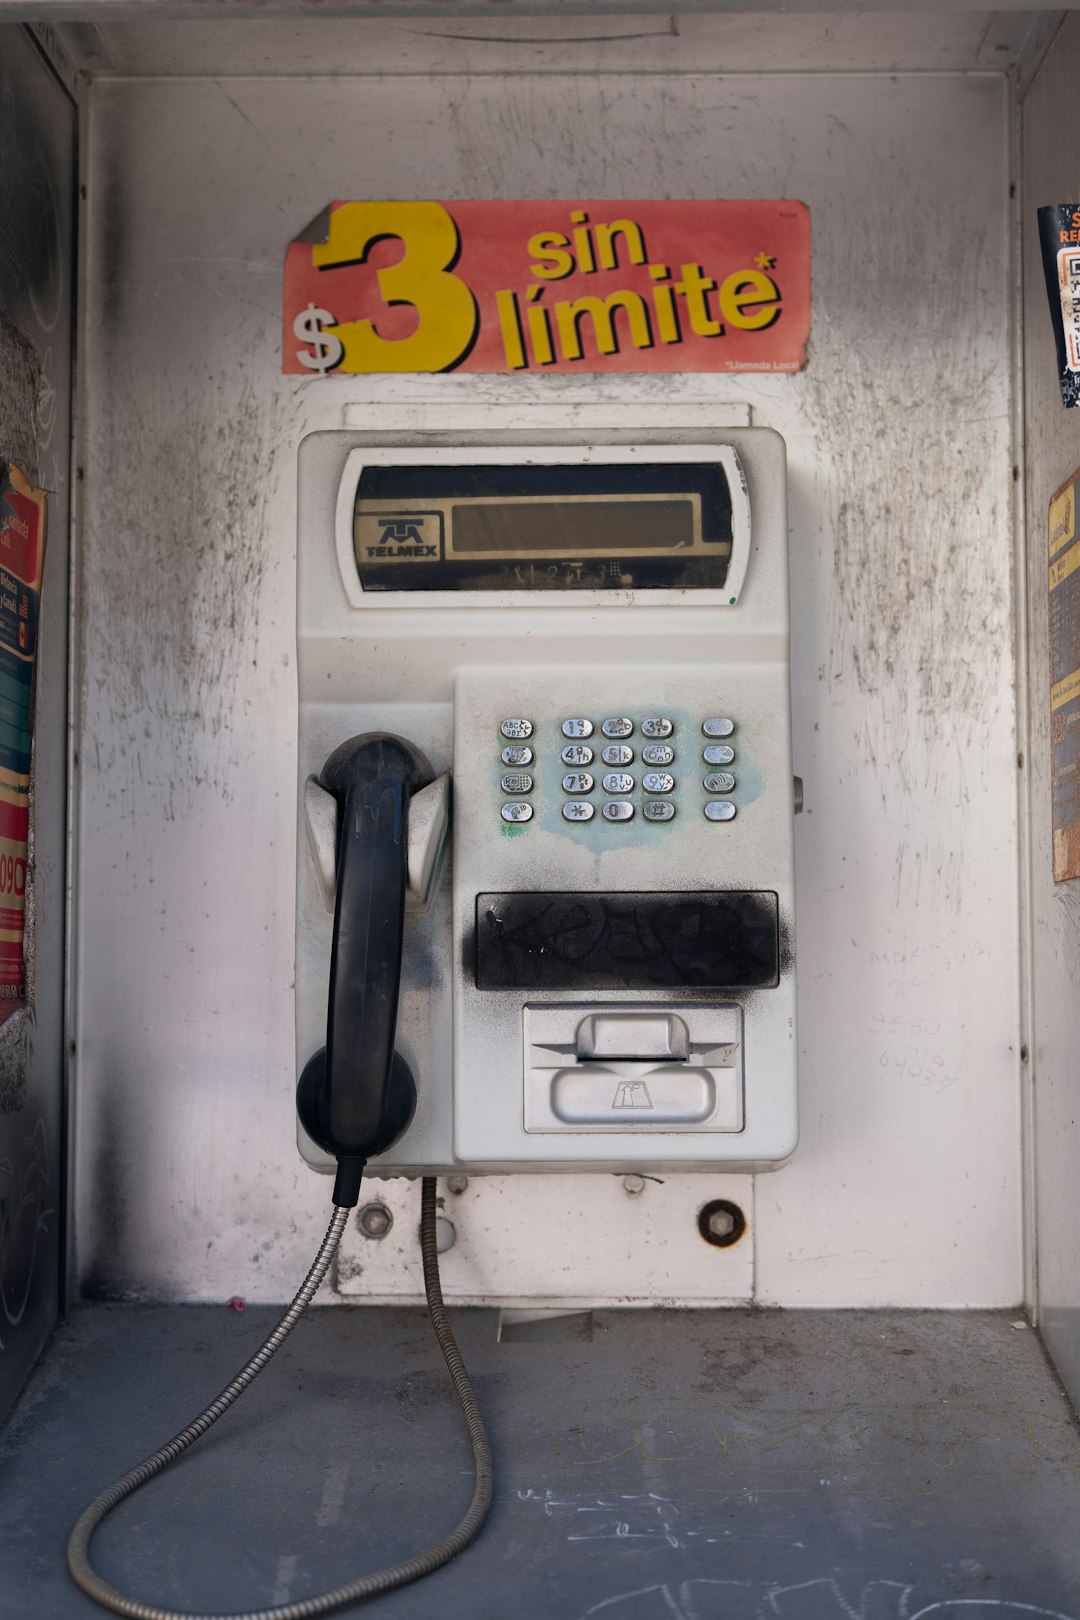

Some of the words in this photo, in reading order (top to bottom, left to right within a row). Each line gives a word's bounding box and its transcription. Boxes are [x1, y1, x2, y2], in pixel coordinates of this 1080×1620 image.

[527, 211, 648, 280] sin
[366, 545, 437, 557] TELMEX
[566, 747, 574, 760] 4
[567, 776, 576, 788] 7
[609, 776, 618, 789] 8
[649, 775, 658, 788] 9
[609, 804, 618, 817] 0
